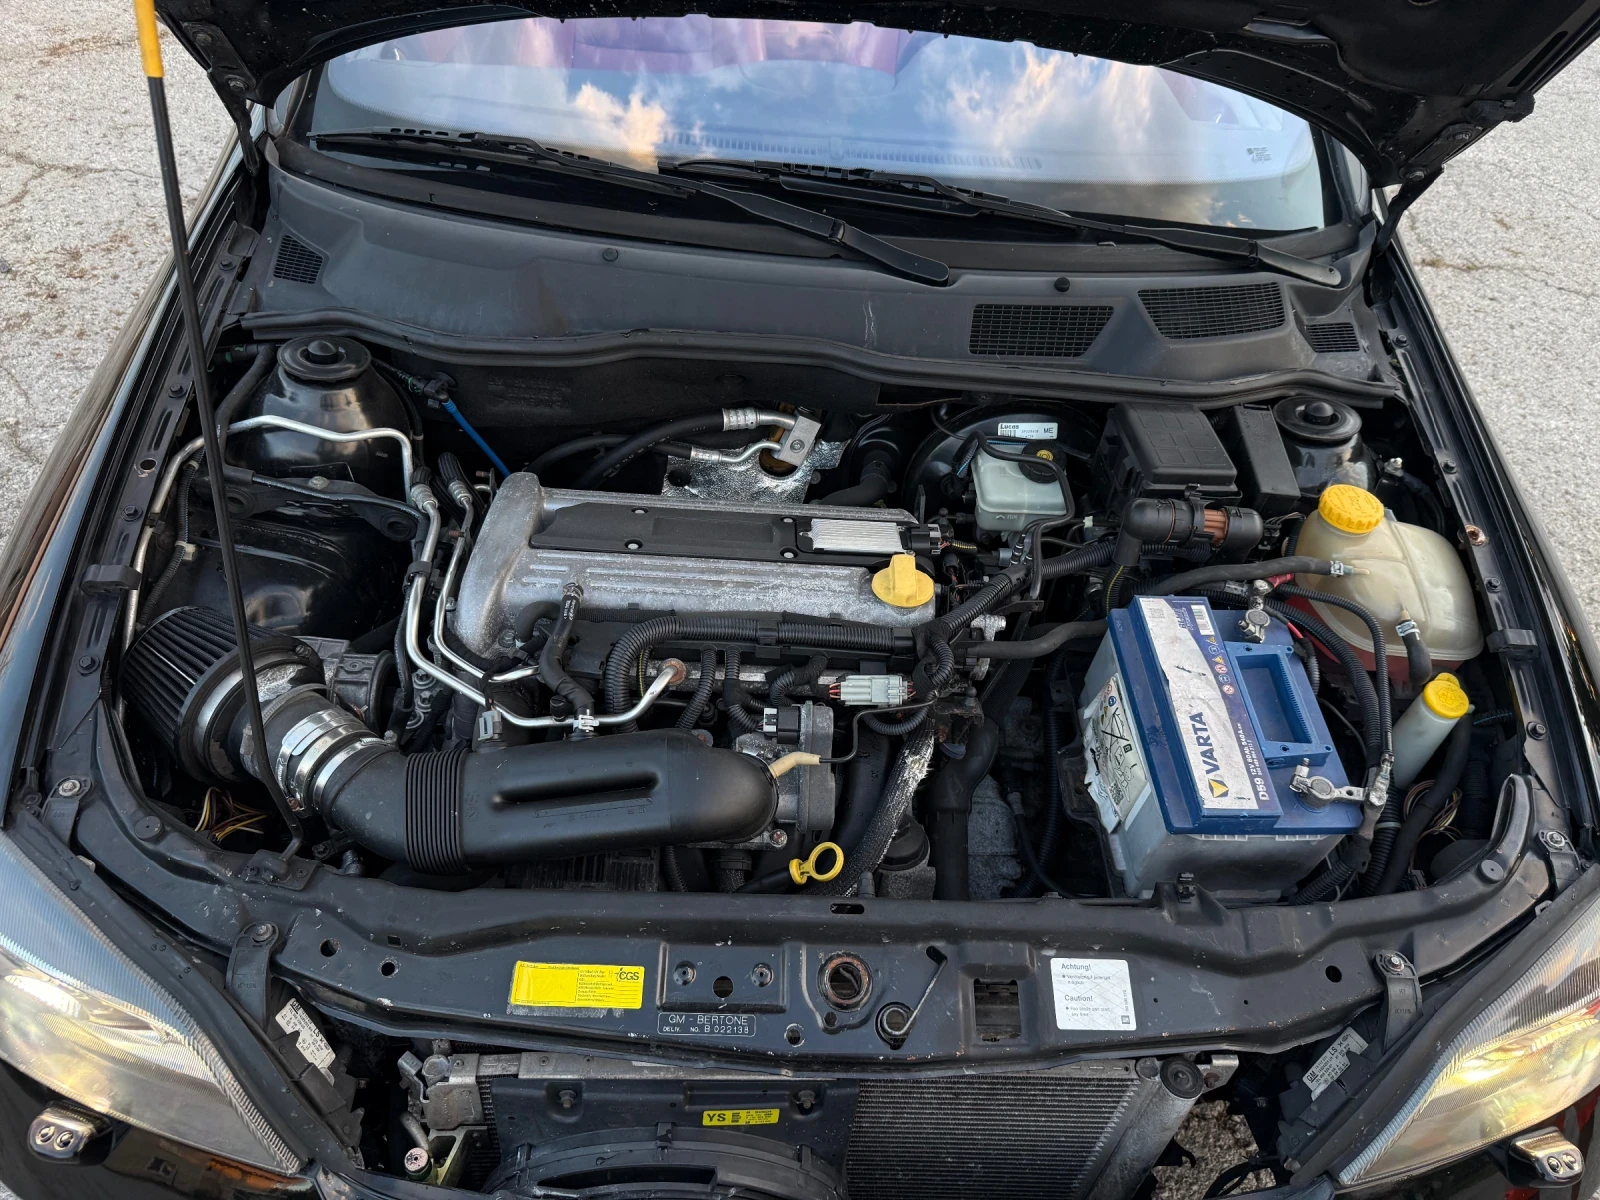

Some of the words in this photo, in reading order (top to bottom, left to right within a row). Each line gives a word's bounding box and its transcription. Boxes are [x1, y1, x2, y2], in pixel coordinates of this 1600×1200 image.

[1189, 712, 1220, 774] VARTA
[1248, 763, 1257, 775] 12V
[1254, 777, 1270, 800] D59
[1061, 963, 1091, 971] Achtung!
[618, 969, 640, 981] CGS
[1064, 994, 1093, 1002] Caution!
[668, 1014, 686, 1024] GM
[697, 1014, 748, 1025] BERTONE
[704, 1025, 711, 1033] B
[713, 1025, 749, 1034] 022138
[1329, 1047, 1338, 1056] LS
[1306, 1070, 1318, 1082] GM
[707, 1113, 726, 1122] YS
